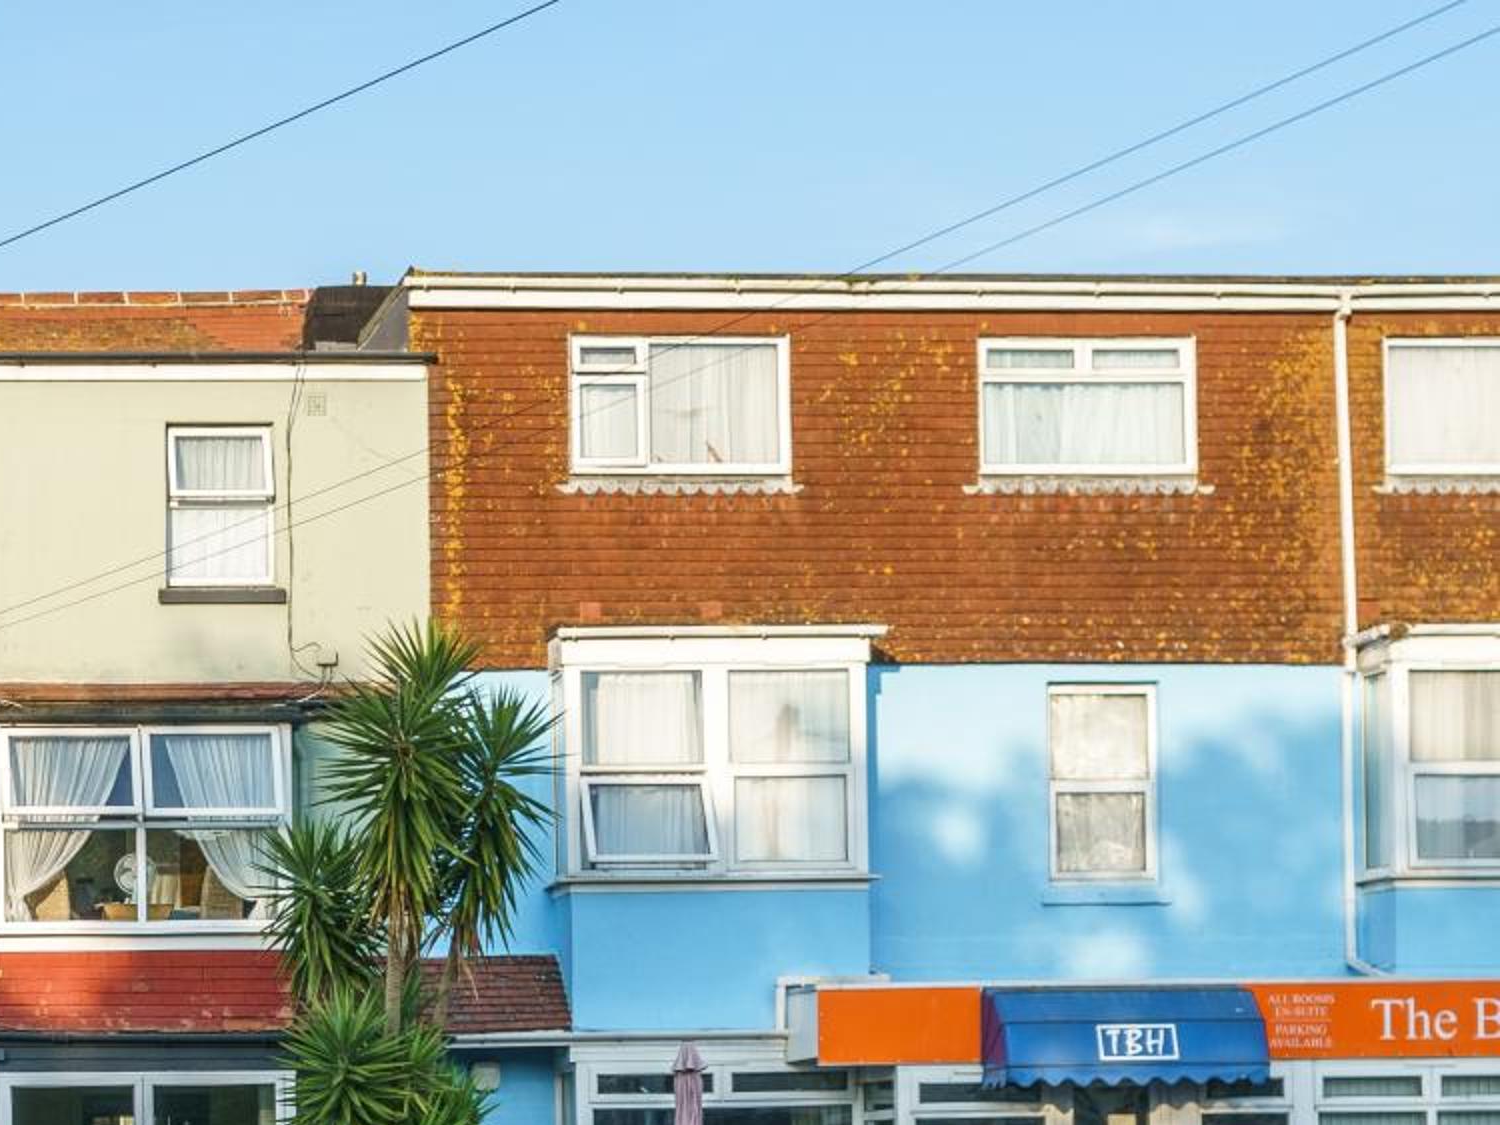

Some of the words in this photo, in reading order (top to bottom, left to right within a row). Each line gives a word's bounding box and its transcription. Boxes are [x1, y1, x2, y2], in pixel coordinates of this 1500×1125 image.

[1268, 993, 1287, 1004] ALL
[1292, 993, 1335, 1004] ROOMS
[1371, 996, 1458, 1041] The
[1275, 1023, 1327, 1035] PARKING
[1105, 1028, 1165, 1056] TBH
[1268, 1036, 1333, 1048] AVAILABLE
